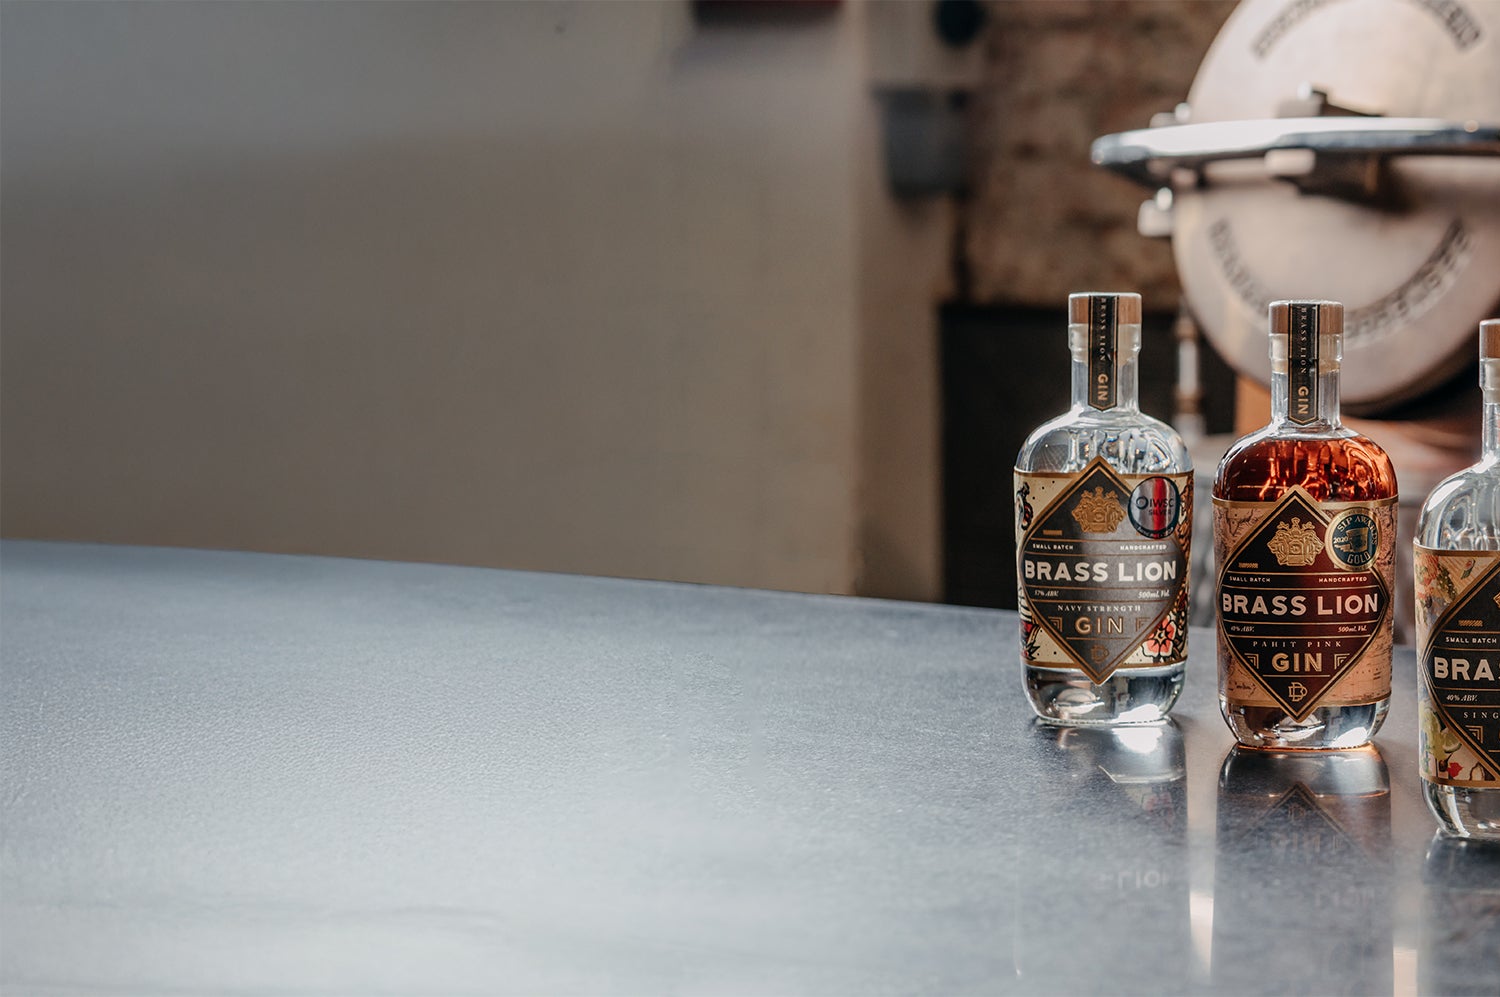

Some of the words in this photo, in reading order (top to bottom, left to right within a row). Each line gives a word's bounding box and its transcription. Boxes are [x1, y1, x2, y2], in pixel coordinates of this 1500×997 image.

[1097, 374, 1109, 401] GIN
[1298, 386, 1309, 415] GIN
[1337, 516, 1352, 532] SIP
[1333, 536, 1348, 544] 2020
[1347, 551, 1371, 564] GOLD
[1024, 560, 1108, 582] BRASS
[1118, 560, 1176, 582] LION
[1057, 604, 1082, 612] NAVY
[1222, 593, 1307, 616] BRASS
[1317, 593, 1378, 616] LION
[1074, 616, 1124, 635] GIN
[1445, 636, 1470, 644] SMALL
[1271, 652, 1322, 672] GIN
[1446, 694, 1460, 702] 40%
